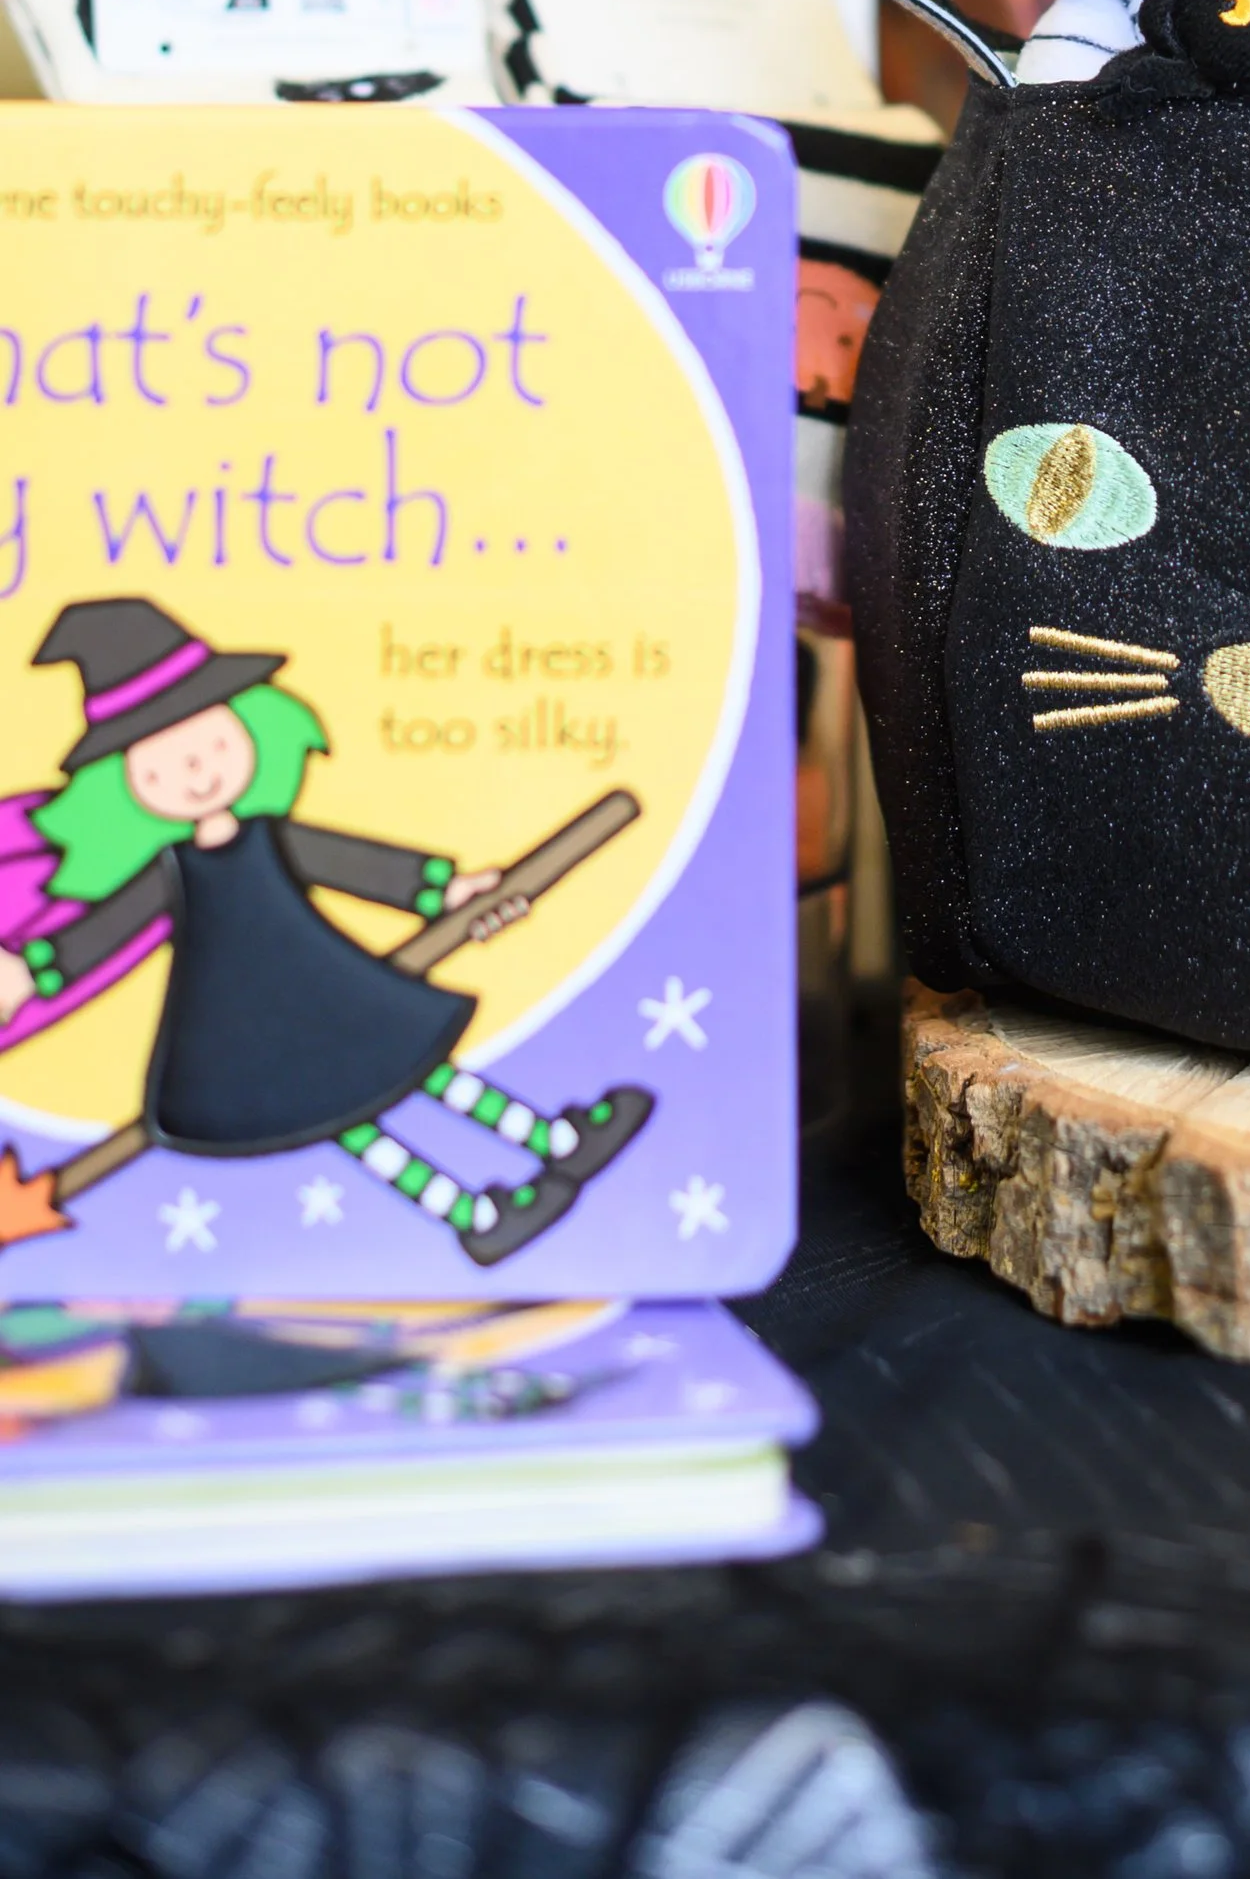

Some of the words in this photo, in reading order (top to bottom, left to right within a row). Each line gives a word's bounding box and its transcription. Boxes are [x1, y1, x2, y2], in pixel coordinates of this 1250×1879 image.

[73, 169, 353, 235] touchy-feely
[370, 177, 503, 221] books
[314, 294, 550, 412] not
[92, 427, 569, 568] witch...
[380, 622, 467, 678] her
[481, 625, 615, 682] dress
[631, 631, 671, 678] is
[381, 707, 478, 752] too
